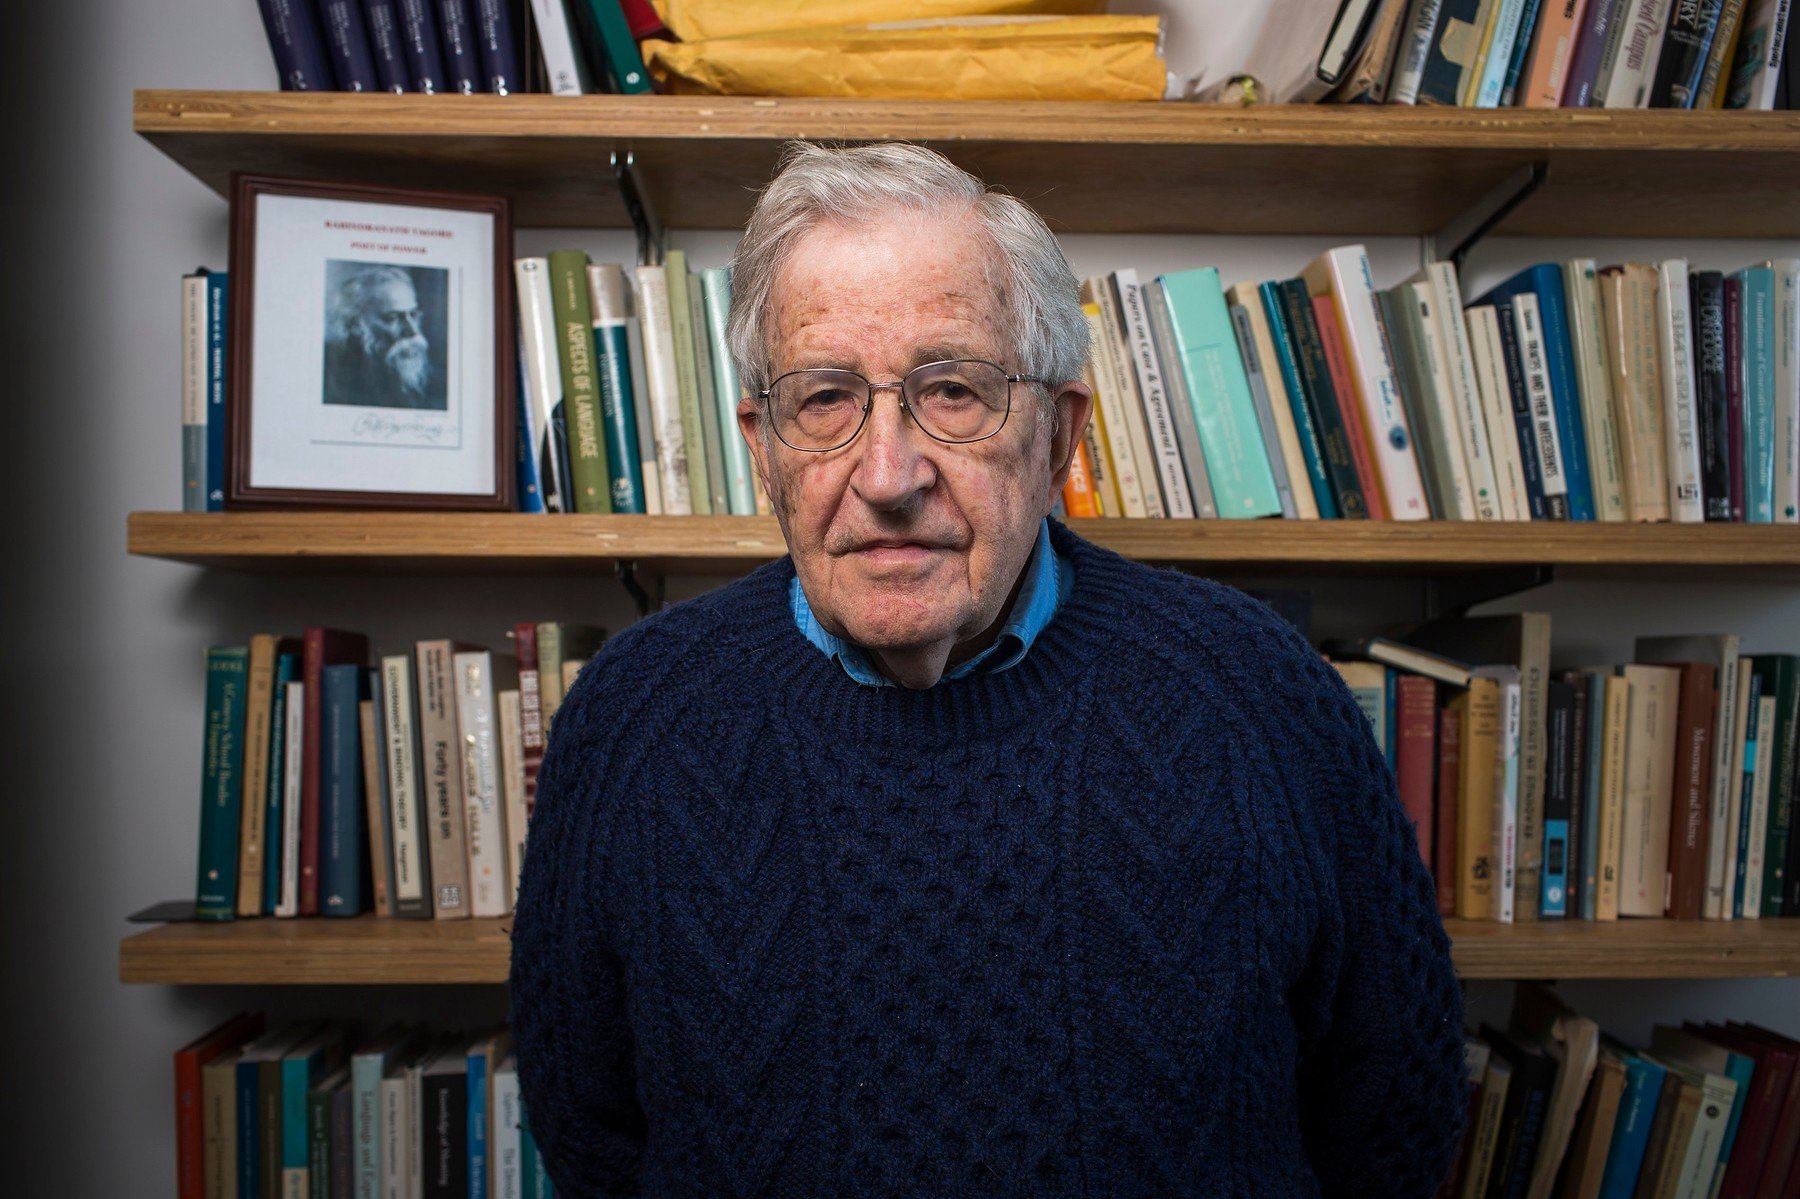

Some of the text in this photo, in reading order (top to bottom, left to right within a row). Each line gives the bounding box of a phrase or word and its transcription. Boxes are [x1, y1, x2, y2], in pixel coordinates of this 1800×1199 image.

[1626, 24, 1658, 70] Campus
[1699, 306, 1715, 373] LANGUAGE
[1755, 292, 1765, 348] Foundations
[1124, 283, 1143, 323] Papers
[1139, 341, 1154, 369] Case
[1148, 387, 1172, 449] Agreement
[1525, 339, 1541, 371] TRACES
[566, 320, 597, 459] ASPECTS OF LANGUAGE
[1530, 373, 1544, 391] AND
[1671, 309, 1692, 450] SURFACE STRUCTURE
[1756, 364, 1766, 413] Generative
[1533, 394, 1548, 417] THEIR
[1537, 420, 1558, 478] ANTECEDENTS
[1756, 416, 1766, 446] Syntax
[387, 666, 401, 734] GOVERNMENT
[207, 723, 220, 776] Linguistics
[219, 731, 232, 767] School
[393, 747, 404, 788] BINDING
[1689, 727, 1704, 785] Movement
[217, 769, 230, 806] Reader
[396, 791, 407, 830] THEORY
[434, 740, 451, 839] Forty years on
[1688, 787, 1701, 807] and
[1685, 810, 1699, 849] Silence
[360, 1090, 374, 1144] Language
[436, 1088, 449, 1135] Knowledge
[361, 1148, 374, 1168] and
[438, 1148, 450, 1185] Meaning
[503, 1148, 515, 1165] The
